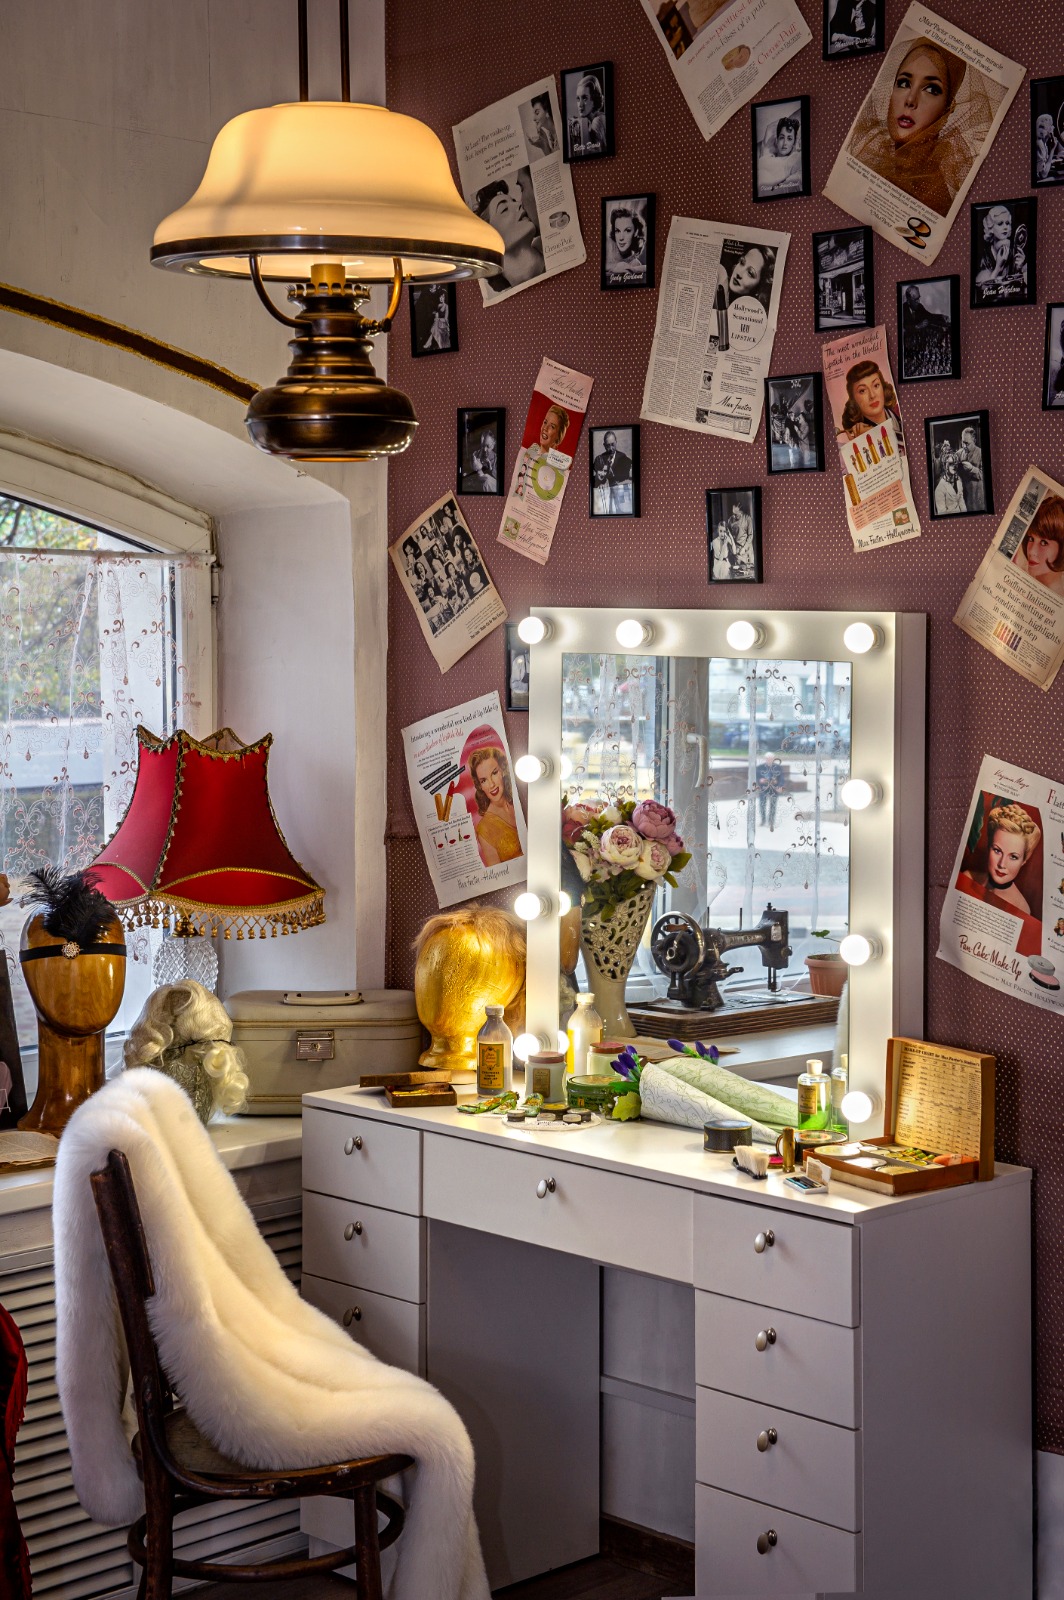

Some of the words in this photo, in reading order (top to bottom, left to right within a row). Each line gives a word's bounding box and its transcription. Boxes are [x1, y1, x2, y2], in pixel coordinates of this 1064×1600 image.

[949, 34, 964, 46] creates
[986, 56, 1004, 70] miracle
[976, 59, 993, 73] Powder
[983, 286, 997, 299] Jean
[733, 304, 764, 315] Hollywood's
[733, 314, 764, 325] Sensational
[825, 348, 835, 357] The
[838, 343, 850, 353] most
[851, 330, 880, 349] wonderful
[852, 350, 861, 359] the
[862, 340, 883, 356] World!
[716, 395, 734, 408] Max
[732, 397, 753, 413] Factor
[518, 535, 547, 553] Hollywood
[857, 538, 870, 548] Max
[1003, 574, 1026, 596] Coiffure
[1026, 591, 1055, 615] Italienne
[995, 582, 1006, 593] new
[1007, 590, 1044, 621] hair-setting
[1043, 618, 1056, 628] gel
[993, 603, 999, 613] in
[1000, 611, 1011, 621] one
[1024, 628, 1038, 642] step
[434, 719, 455, 733] wonderful
[463, 713, 473, 723] kind
[958, 935, 990, 961] Pan-Cake
[989, 950, 1022, 981] Make-Up
[1001, 978, 1013, 988] MAX
[1013, 984, 1033, 997] FACTOR
